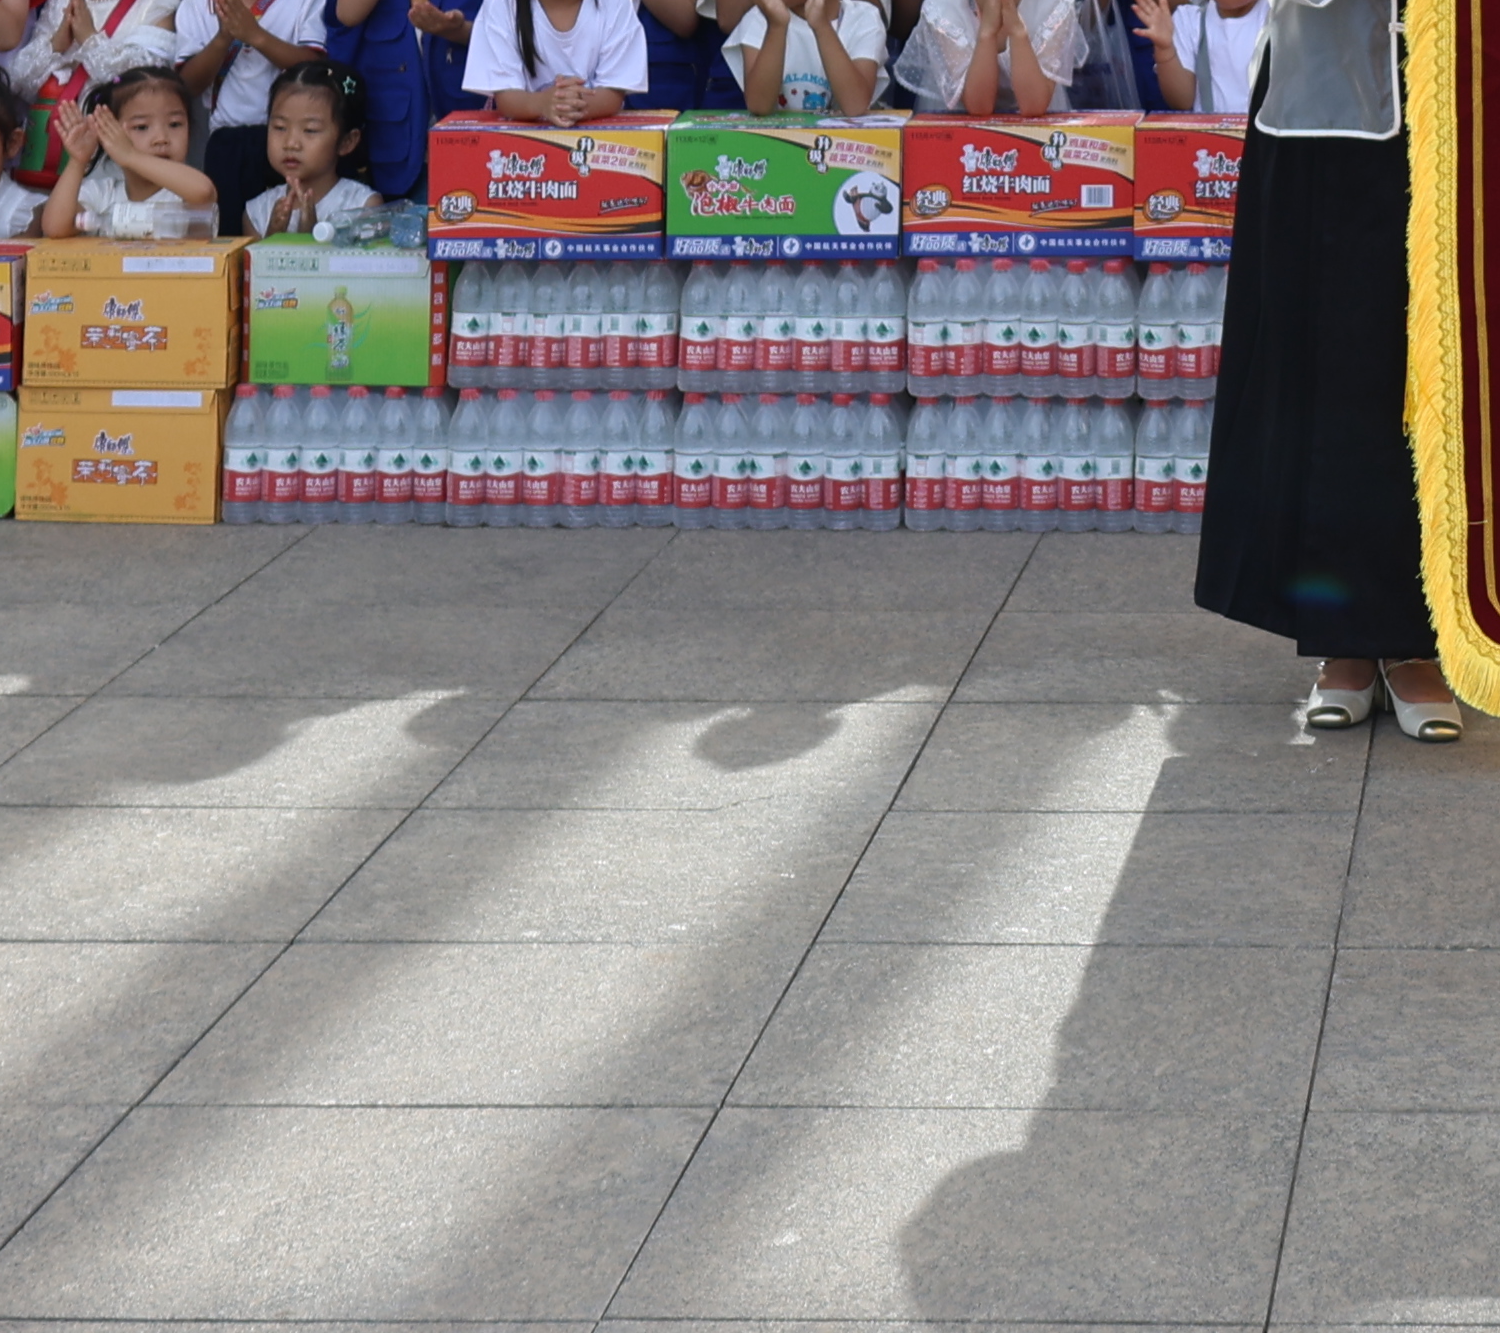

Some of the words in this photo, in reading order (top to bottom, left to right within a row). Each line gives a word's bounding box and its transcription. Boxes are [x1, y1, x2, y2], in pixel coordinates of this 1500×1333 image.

[505, 153, 545, 178] 康师傅
[978, 148, 1018, 171] 康师傅
[732, 157, 768, 179] 康师傅
[488, 181, 577, 199] 红烧牛肉面
[962, 176, 1051, 194] 红烧牛肉面
[441, 196, 473, 212] 经典
[692, 193, 795, 216] 泡椒牛肉面
[916, 191, 948, 207] 经典
[1149, 195, 1180, 212] 经典
[804, 242, 892, 250] 中国航天事业合作伙伴
[1040, 239, 1127, 247] 中国航天事业合作伙伴
[103, 296, 144, 321] 康师傅
[82, 325, 167, 351] 茉莉蜜茶
[456, 341, 487, 351] 农夫山泉
[686, 346, 715, 355] 农夫山泉
[802, 346, 830, 355] 农夫山泉
[869, 346, 898, 355] 农夫山泉
[1022, 352, 1050, 361] 农夫山泉
[1139, 354, 1165, 363] 农夫山泉
[93, 430, 134, 454] 康师傅
[74, 459, 157, 486] 茉莉蜜茶
[306, 478, 335, 487] 农夫山泉
[414, 478, 442, 487] 农夫山泉
[681, 484, 709, 493] 农夫山泉
[791, 484, 820, 493] 农夫山泉
[983, 485, 1011, 494] 农夫山泉
